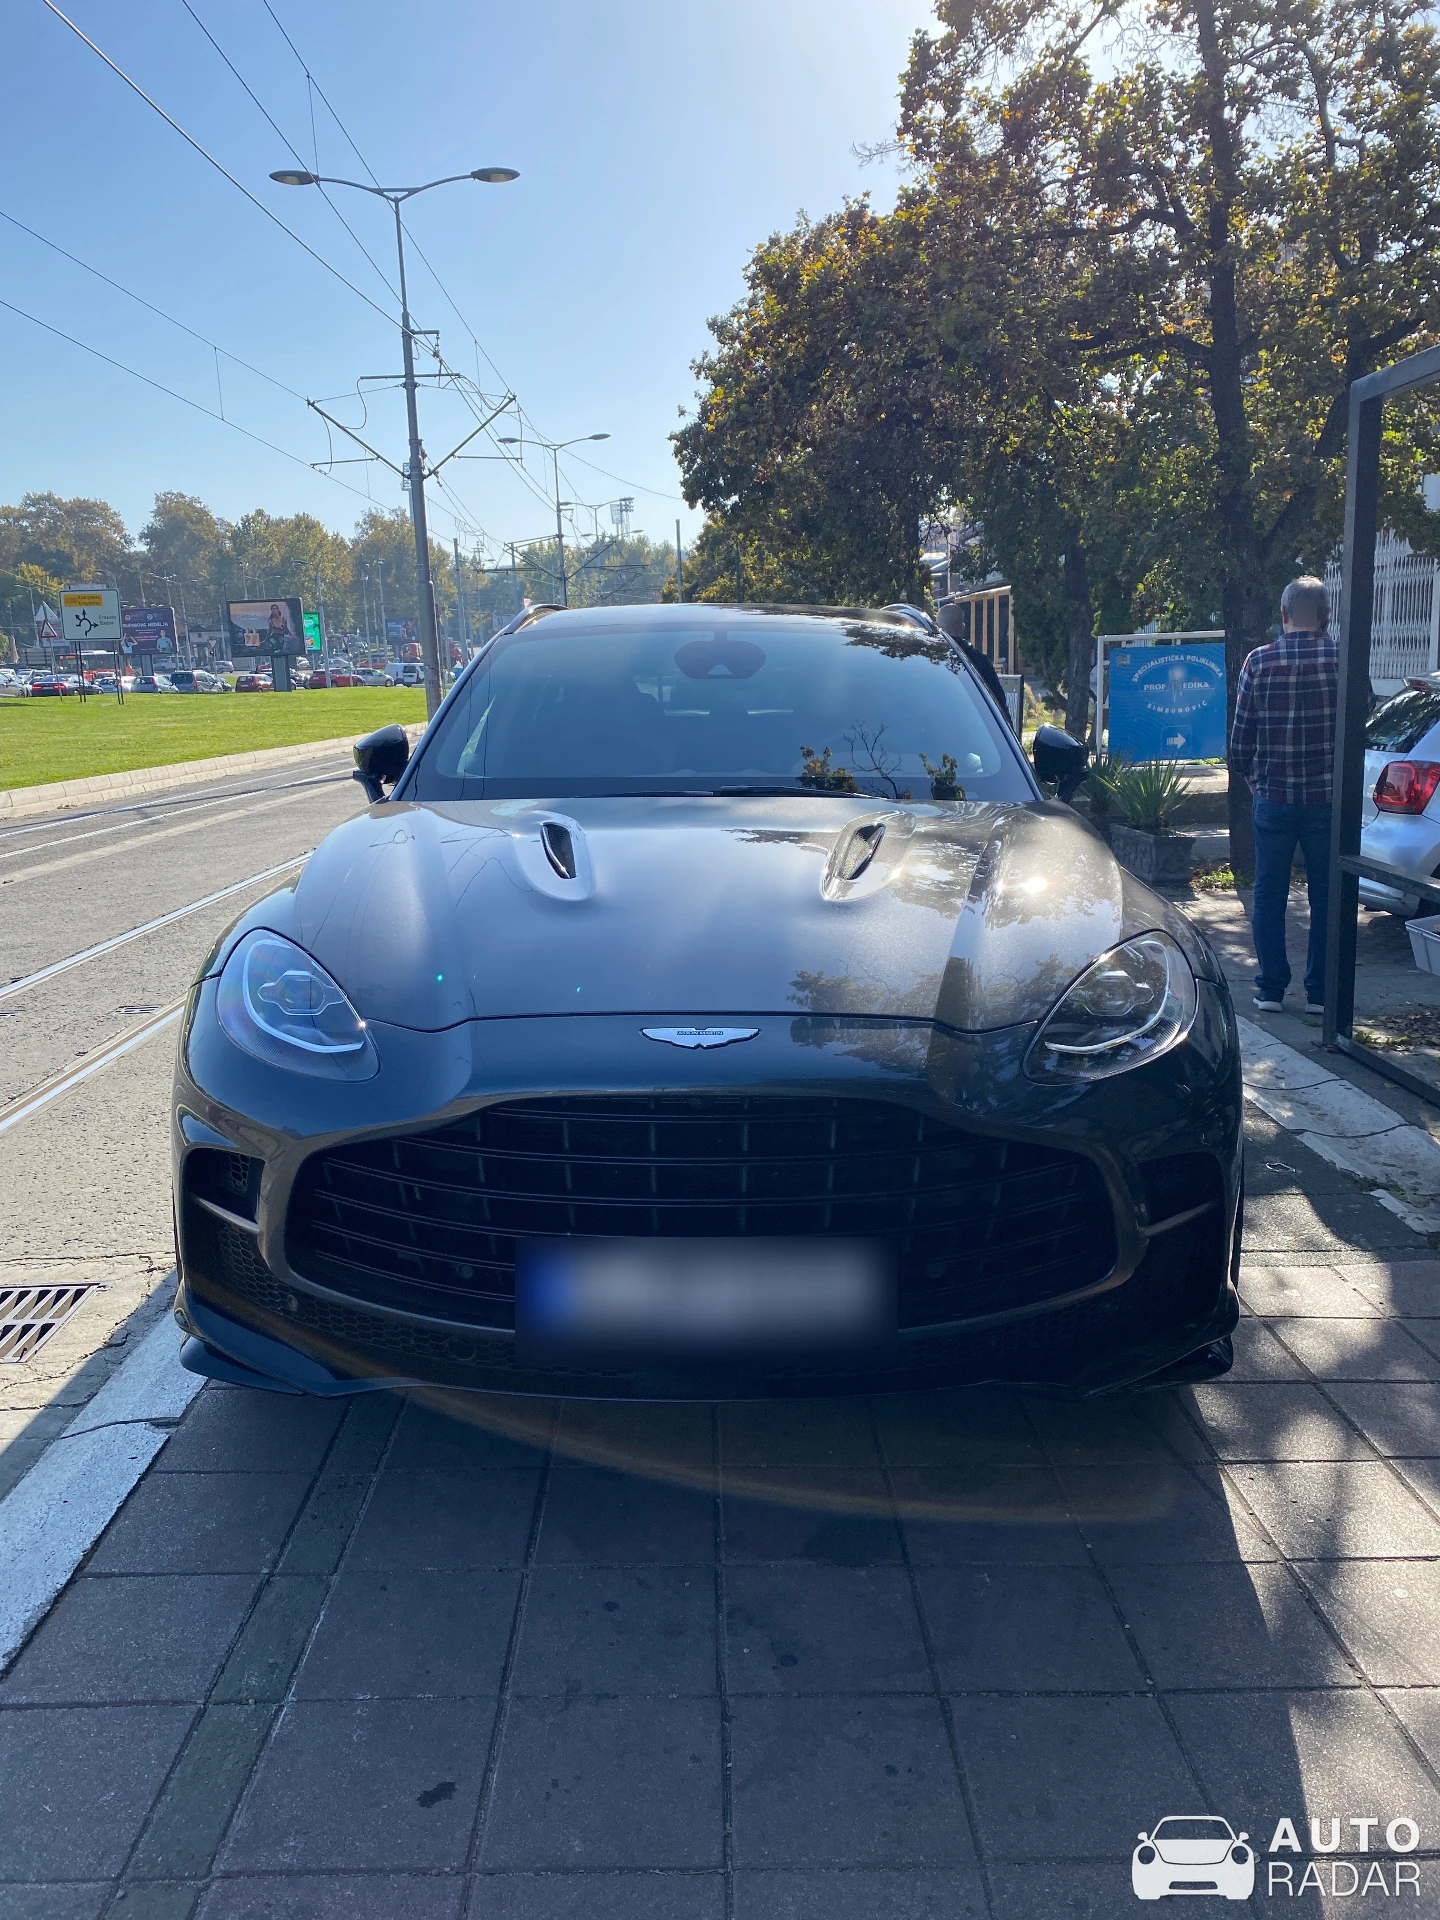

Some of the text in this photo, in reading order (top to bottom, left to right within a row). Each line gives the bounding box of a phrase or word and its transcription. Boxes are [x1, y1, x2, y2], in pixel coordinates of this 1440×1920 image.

[1132, 654, 1223, 682] SPECIJALISTIČKA POLIKLINIKA
[1143, 683, 1167, 691] PROF
